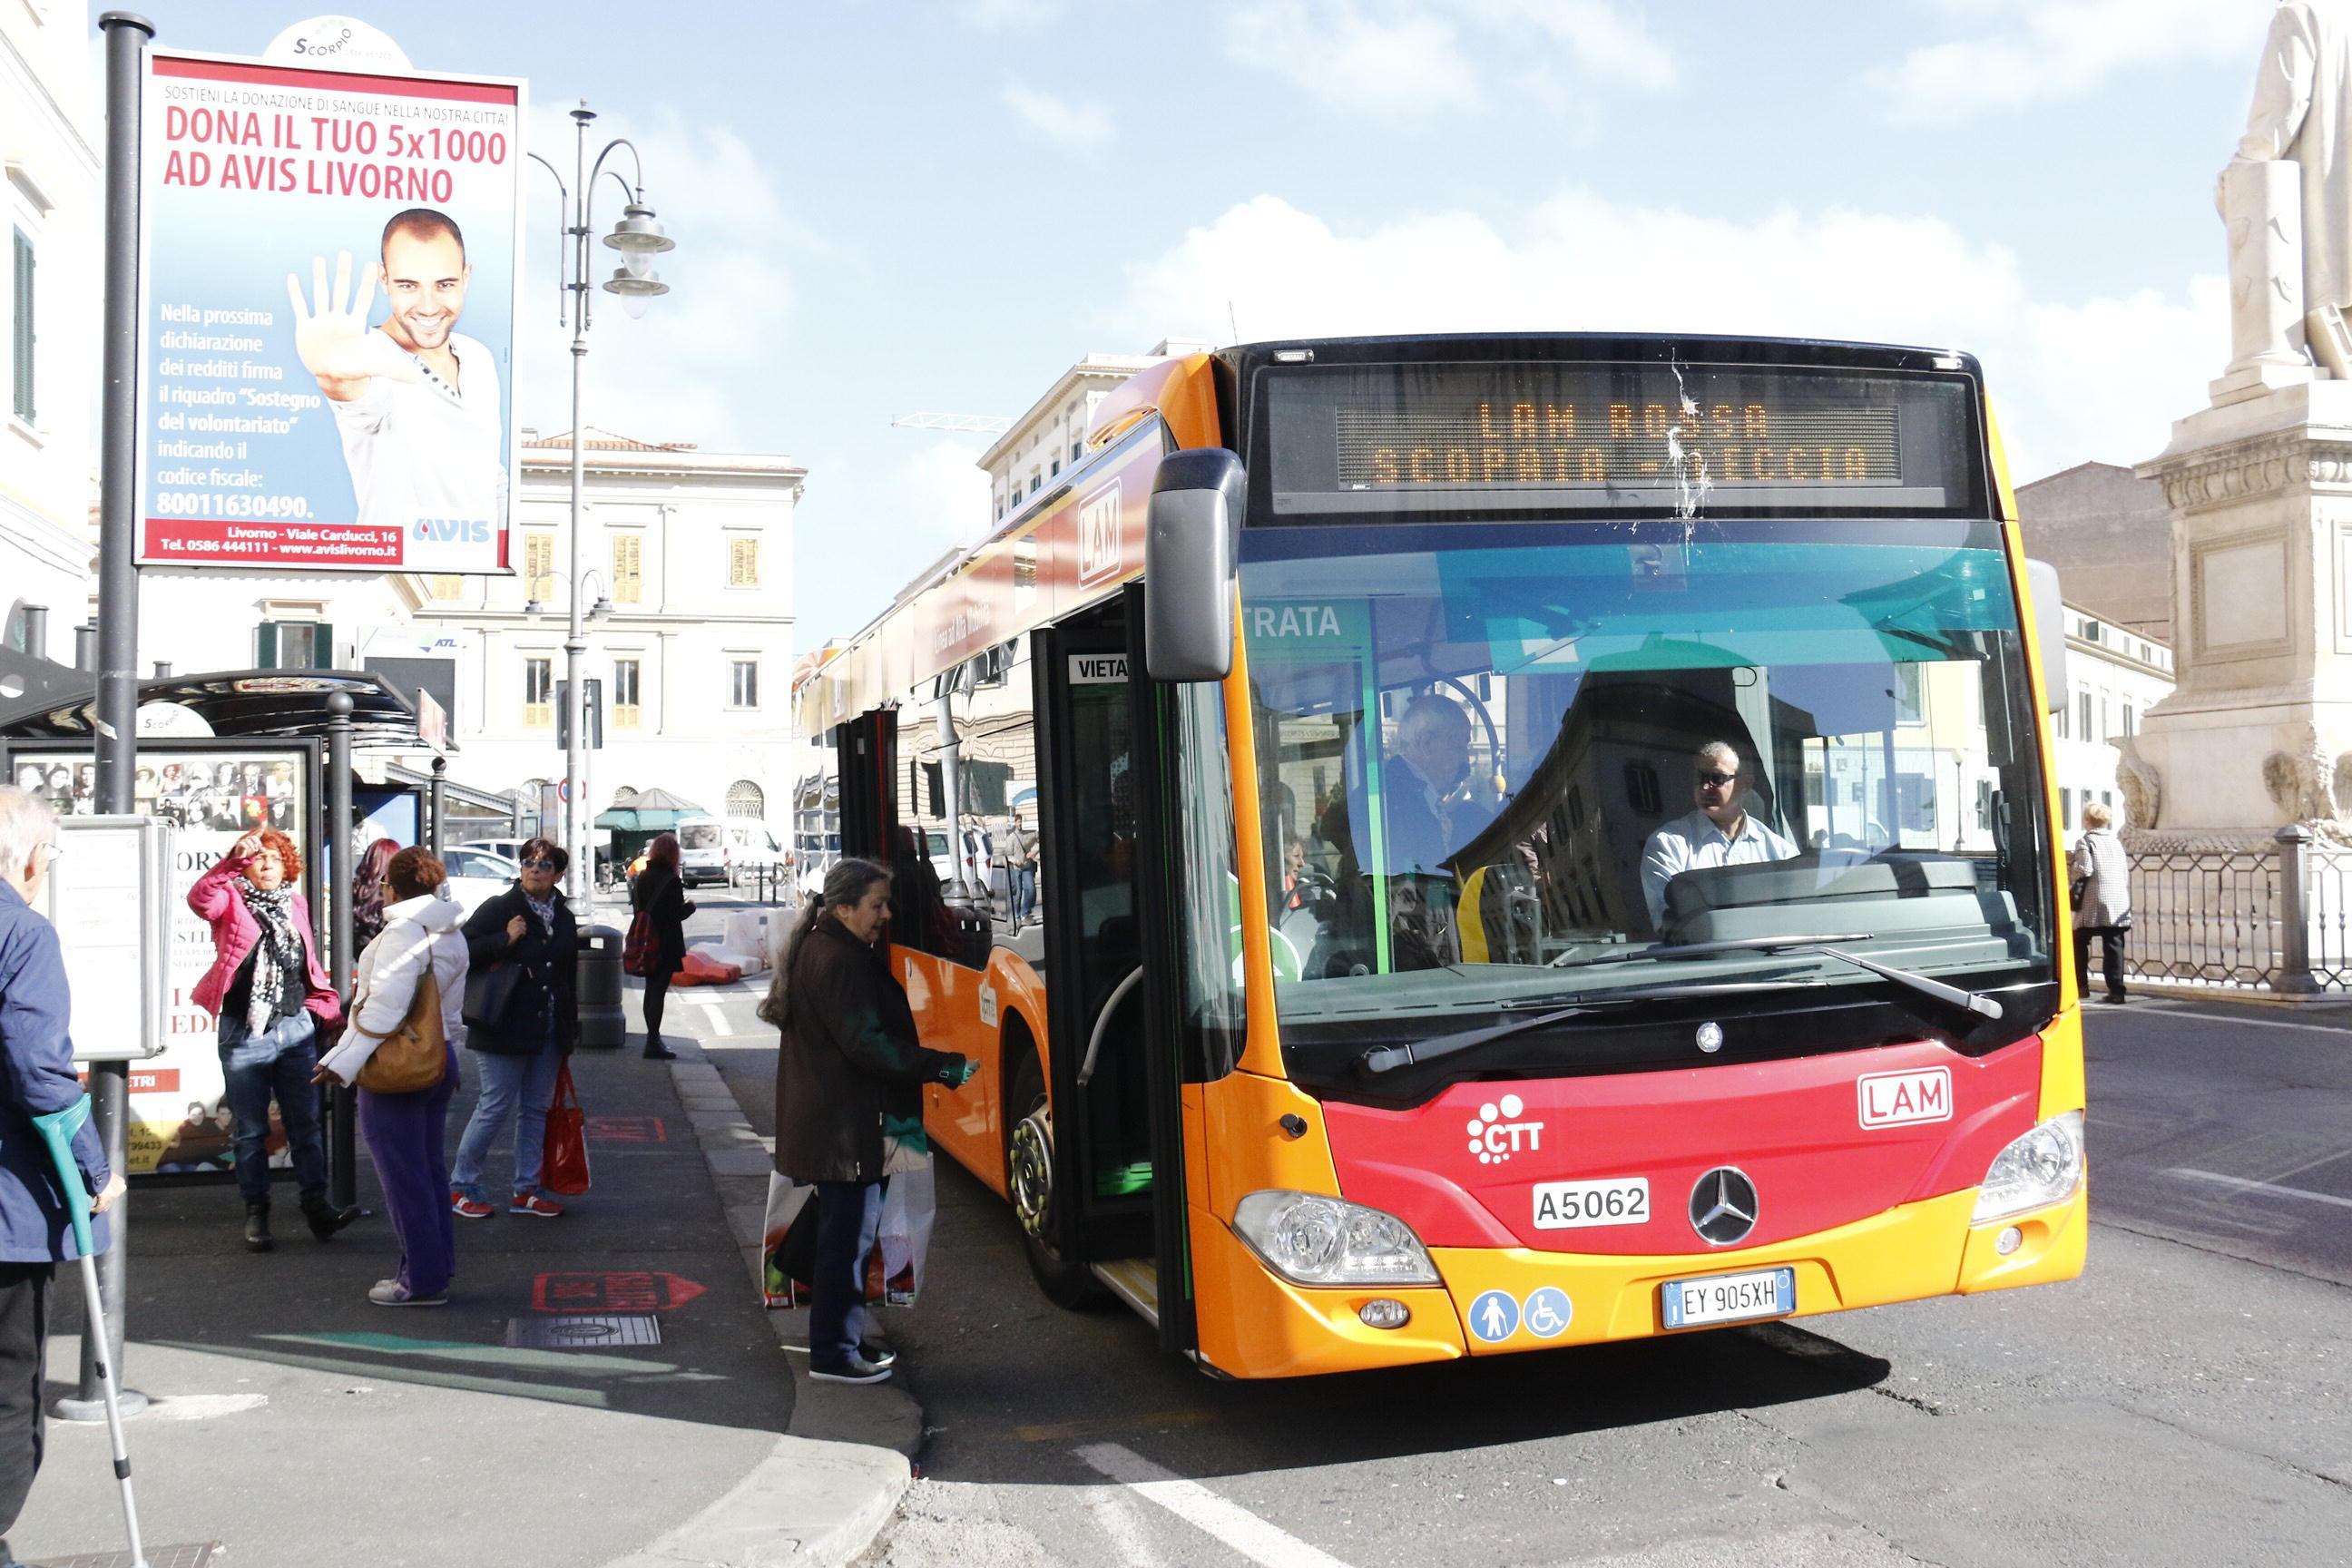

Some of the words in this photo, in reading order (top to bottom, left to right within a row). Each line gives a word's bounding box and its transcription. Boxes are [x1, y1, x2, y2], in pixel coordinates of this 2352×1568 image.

[293, 28, 352, 56] SCORPIO
[165, 85, 220, 103] SOSTIENI
[224, 92, 238, 103] LA
[242, 92, 313, 110] DONAZIONE
[318, 98, 328, 111] DI
[332, 99, 380, 115] SANGUE
[384, 104, 420, 118] NELLA
[424, 107, 470, 123] NOSTRA
[167, 105, 262, 147] DONA
[274, 113, 301, 150] IL
[311, 117, 377, 155] TUO
[387, 124, 505, 164] 5x1000
[163, 150, 211, 187] AD
[220, 153, 297, 191] AVIS
[308, 159, 452, 203] LIVORNO
[161, 303, 201, 322] Nella
[204, 308, 273, 327] prossima
[160, 330, 263, 352] dichiarazione
[159, 358, 183, 376] dei
[188, 359, 238, 378] redditi
[241, 360, 283, 380] firma
[159, 385, 168, 402] il
[172, 387, 236, 407] riquadro
[158, 412, 184, 430] del
[1481, 403, 1574, 438] LAM
[1611, 403, 1768, 439] ROSSA
[158, 440, 234, 459] indicando
[238, 442, 247, 459] il
[157, 467, 206, 486] codice
[210, 467, 263, 487] fiscale:
[1375, 447, 1605, 483] SCOPAIA
[157, 491, 314, 519] 80011630490.
[227, 526, 277, 540] Livorno
[287, 528, 318, 541] Viale
[320, 529, 378, 544] Carducci,
[382, 531, 397, 544] 16
[413, 518, 490, 543] AVIS
[1082, 495, 1117, 573] LAM
[161, 538, 184, 551] Tel.
[187, 539, 220, 552] 0586
[221, 541, 269, 553] 444111
[280, 544, 397, 557] www.avislivorno.it
[435, 639, 457, 647] ATL
[1868, 1077, 1942, 1118] LAM
[1485, 1122, 1544, 1154] CTT
[1537, 1187, 1645, 1221] A5062
[1684, 1288, 1707, 1316] EY
[1714, 1279, 1776, 1312] 905XH
